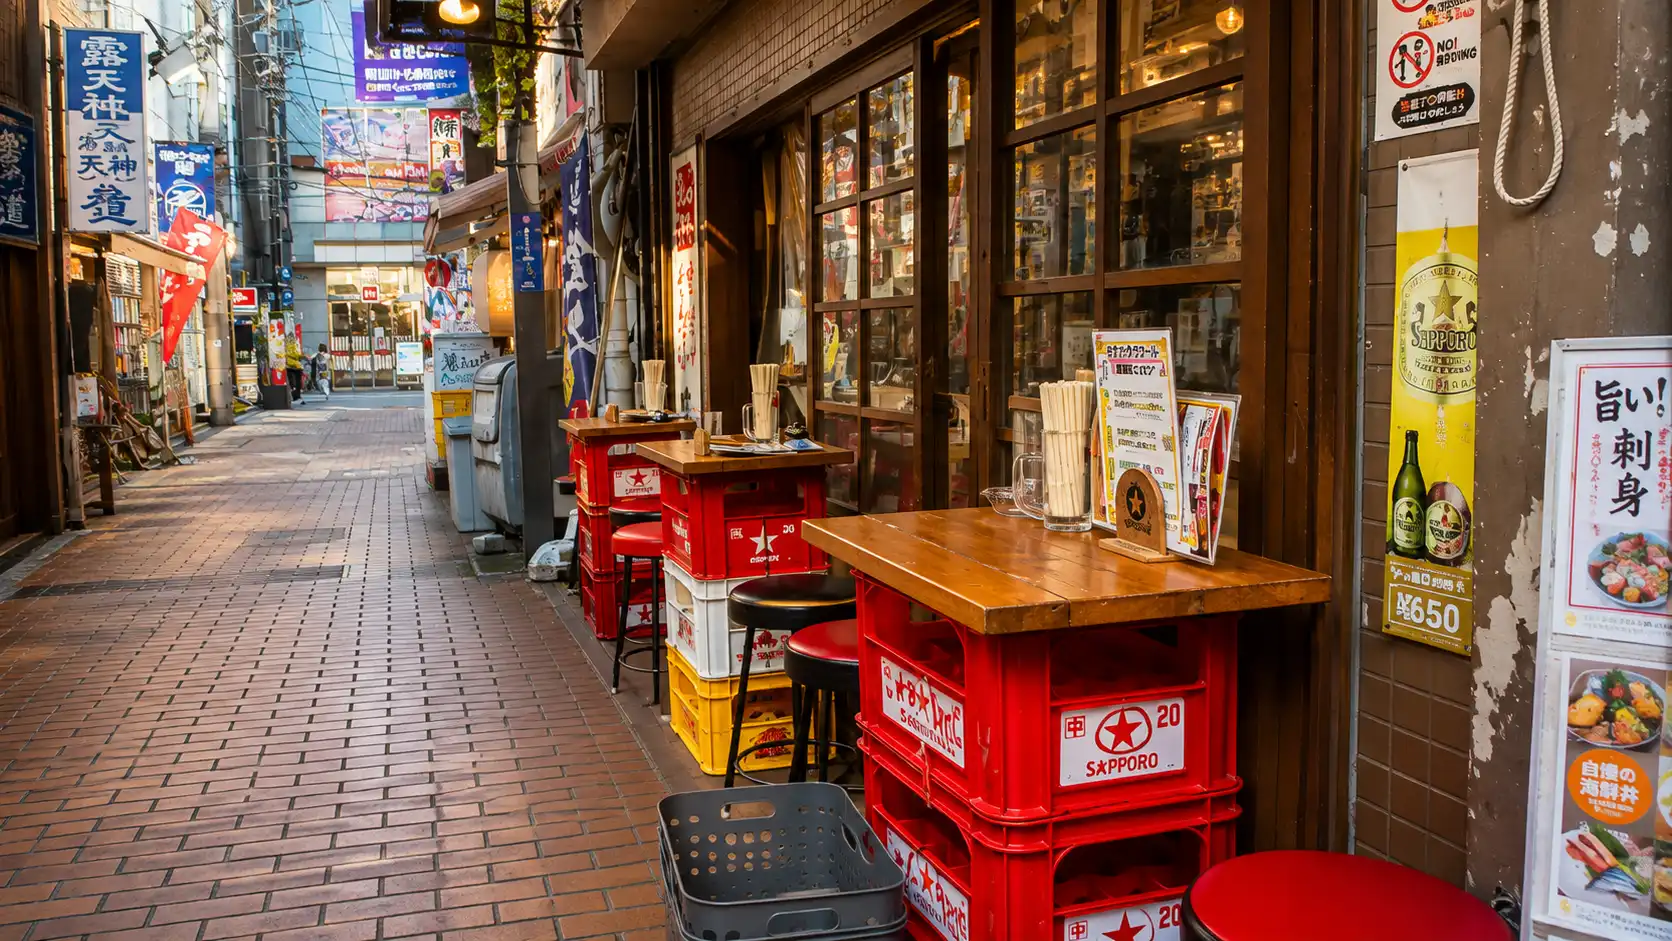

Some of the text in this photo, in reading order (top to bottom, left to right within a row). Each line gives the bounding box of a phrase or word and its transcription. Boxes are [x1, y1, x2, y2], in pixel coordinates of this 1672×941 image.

[1594, 377, 1666, 422] 旨い!
[1609, 427, 1653, 517] 刺身
[1157, 703, 1181, 728] 20
[1158, 903, 1181, 930] 20
